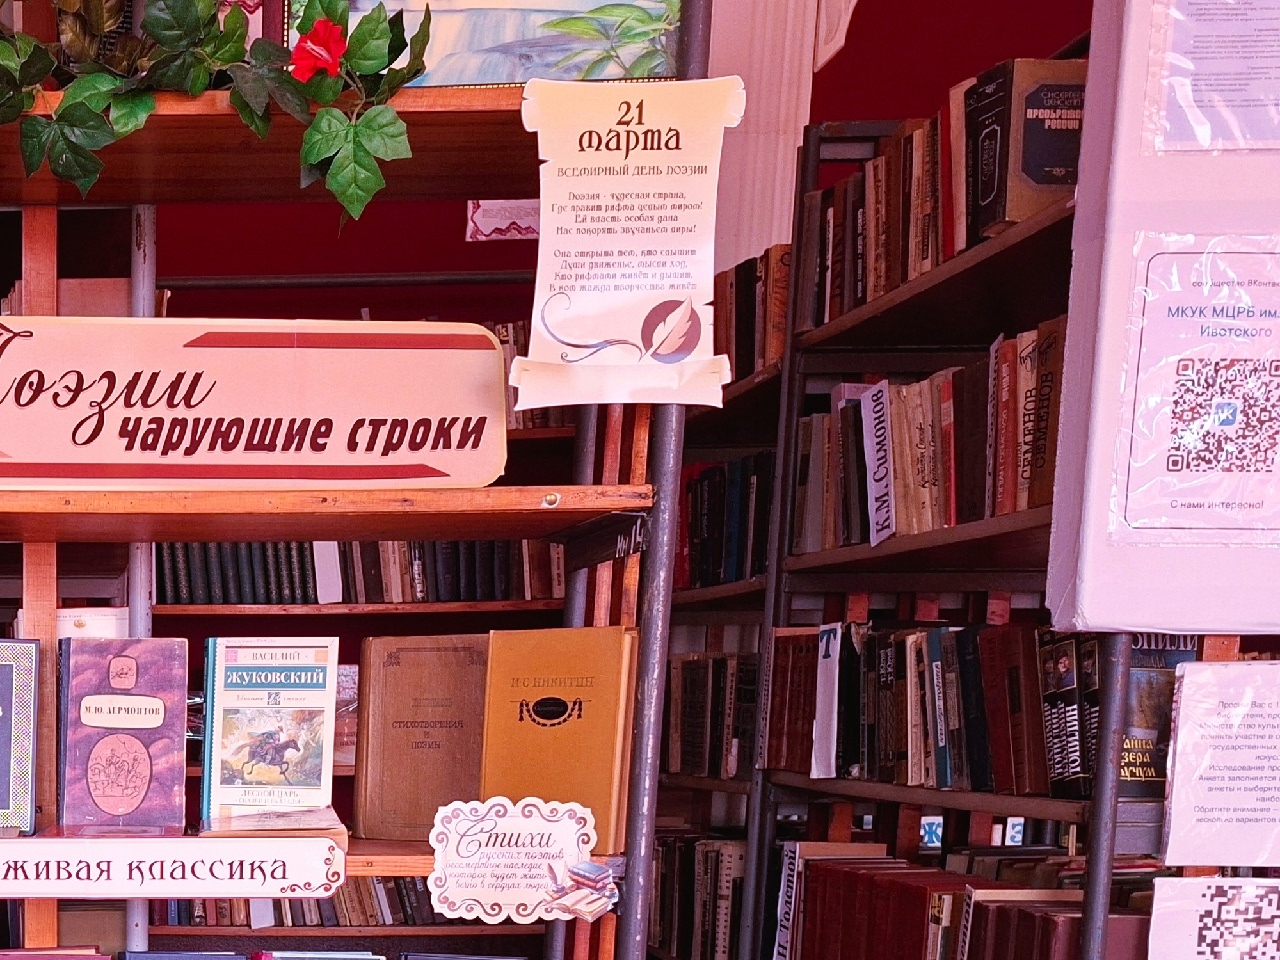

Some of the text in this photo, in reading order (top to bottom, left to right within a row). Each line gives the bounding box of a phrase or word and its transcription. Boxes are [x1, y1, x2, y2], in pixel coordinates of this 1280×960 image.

[615, 99, 646, 128] 21
[578, 126, 683, 160] марта
[557, 163, 708, 178] ВСЕМИРНЫЙ ДЕНЬ ПОЭЗИИ
[568, 191, 686, 203] Поэзия чудесная страна,
[590, 214, 622, 223] власть
[624, 213, 655, 223] особая
[657, 213, 679, 225] дана
[556, 225, 573, 235] Нас
[576, 225, 618, 237] покорять
[620, 225, 668, 237] звучаньем
[553, 248, 572, 259] Она
[574, 249, 615, 259] открыта
[640, 249, 658, 258] кто
[660, 248, 697, 257] слышит
[561, 259, 586, 270] Души
[588, 260, 635, 270] движенье,
[637, 260, 667, 269] мысли
[1167, 306, 1208, 319] МКУК
[1211, 305, 1256, 320] МЦРБ
[118, 416, 488, 457] чарующие строки
[1170, 500, 1264, 512] С нами интересно!
[819, 628, 838, 659] Т
[252, 650, 300, 661] ВАСИЛИЙ
[227, 668, 324, 685] ЖУКОВСКИЙ
[106, 706, 161, 715] ЛЕРМОНТОВ
[392, 720, 464, 730] СТИХОТВОРЕНИЯ
[411, 740, 441, 750] ПОЭМЫ
[455, 818, 557, 859] Стихи
[920, 820, 943, 844] Ж
[478, 848, 565, 861] русских поэтов
[1, 857, 114, 882] живая
[126, 856, 289, 888] классика
[448, 871, 488, 881] которое
[489, 869, 518, 882] будет
